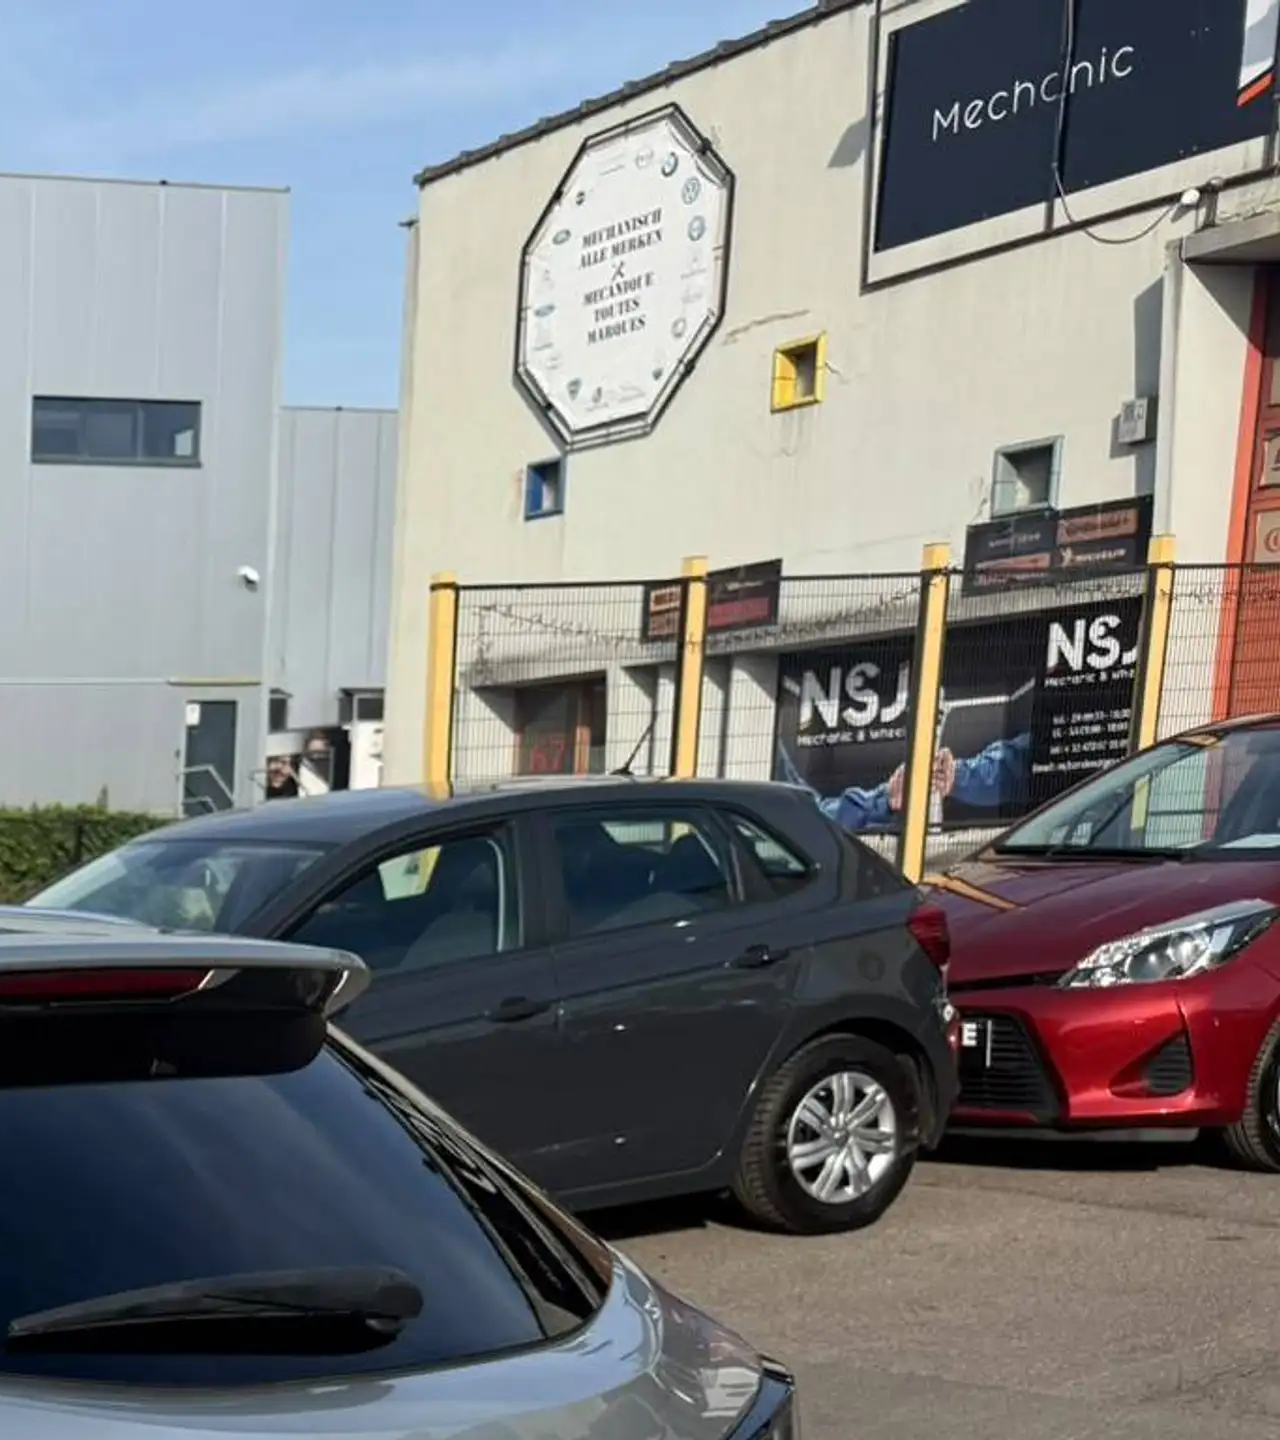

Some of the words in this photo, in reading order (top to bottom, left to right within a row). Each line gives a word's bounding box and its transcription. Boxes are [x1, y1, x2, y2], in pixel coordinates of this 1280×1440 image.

[582, 207, 662, 247] MECHANISCH
[579, 248, 608, 269] ALLE
[610, 229, 663, 256] MERKEN
[587, 315, 647, 345] MARQUES
[594, 299, 641, 323] TOUTES
[799, 661, 910, 731] NSJ
